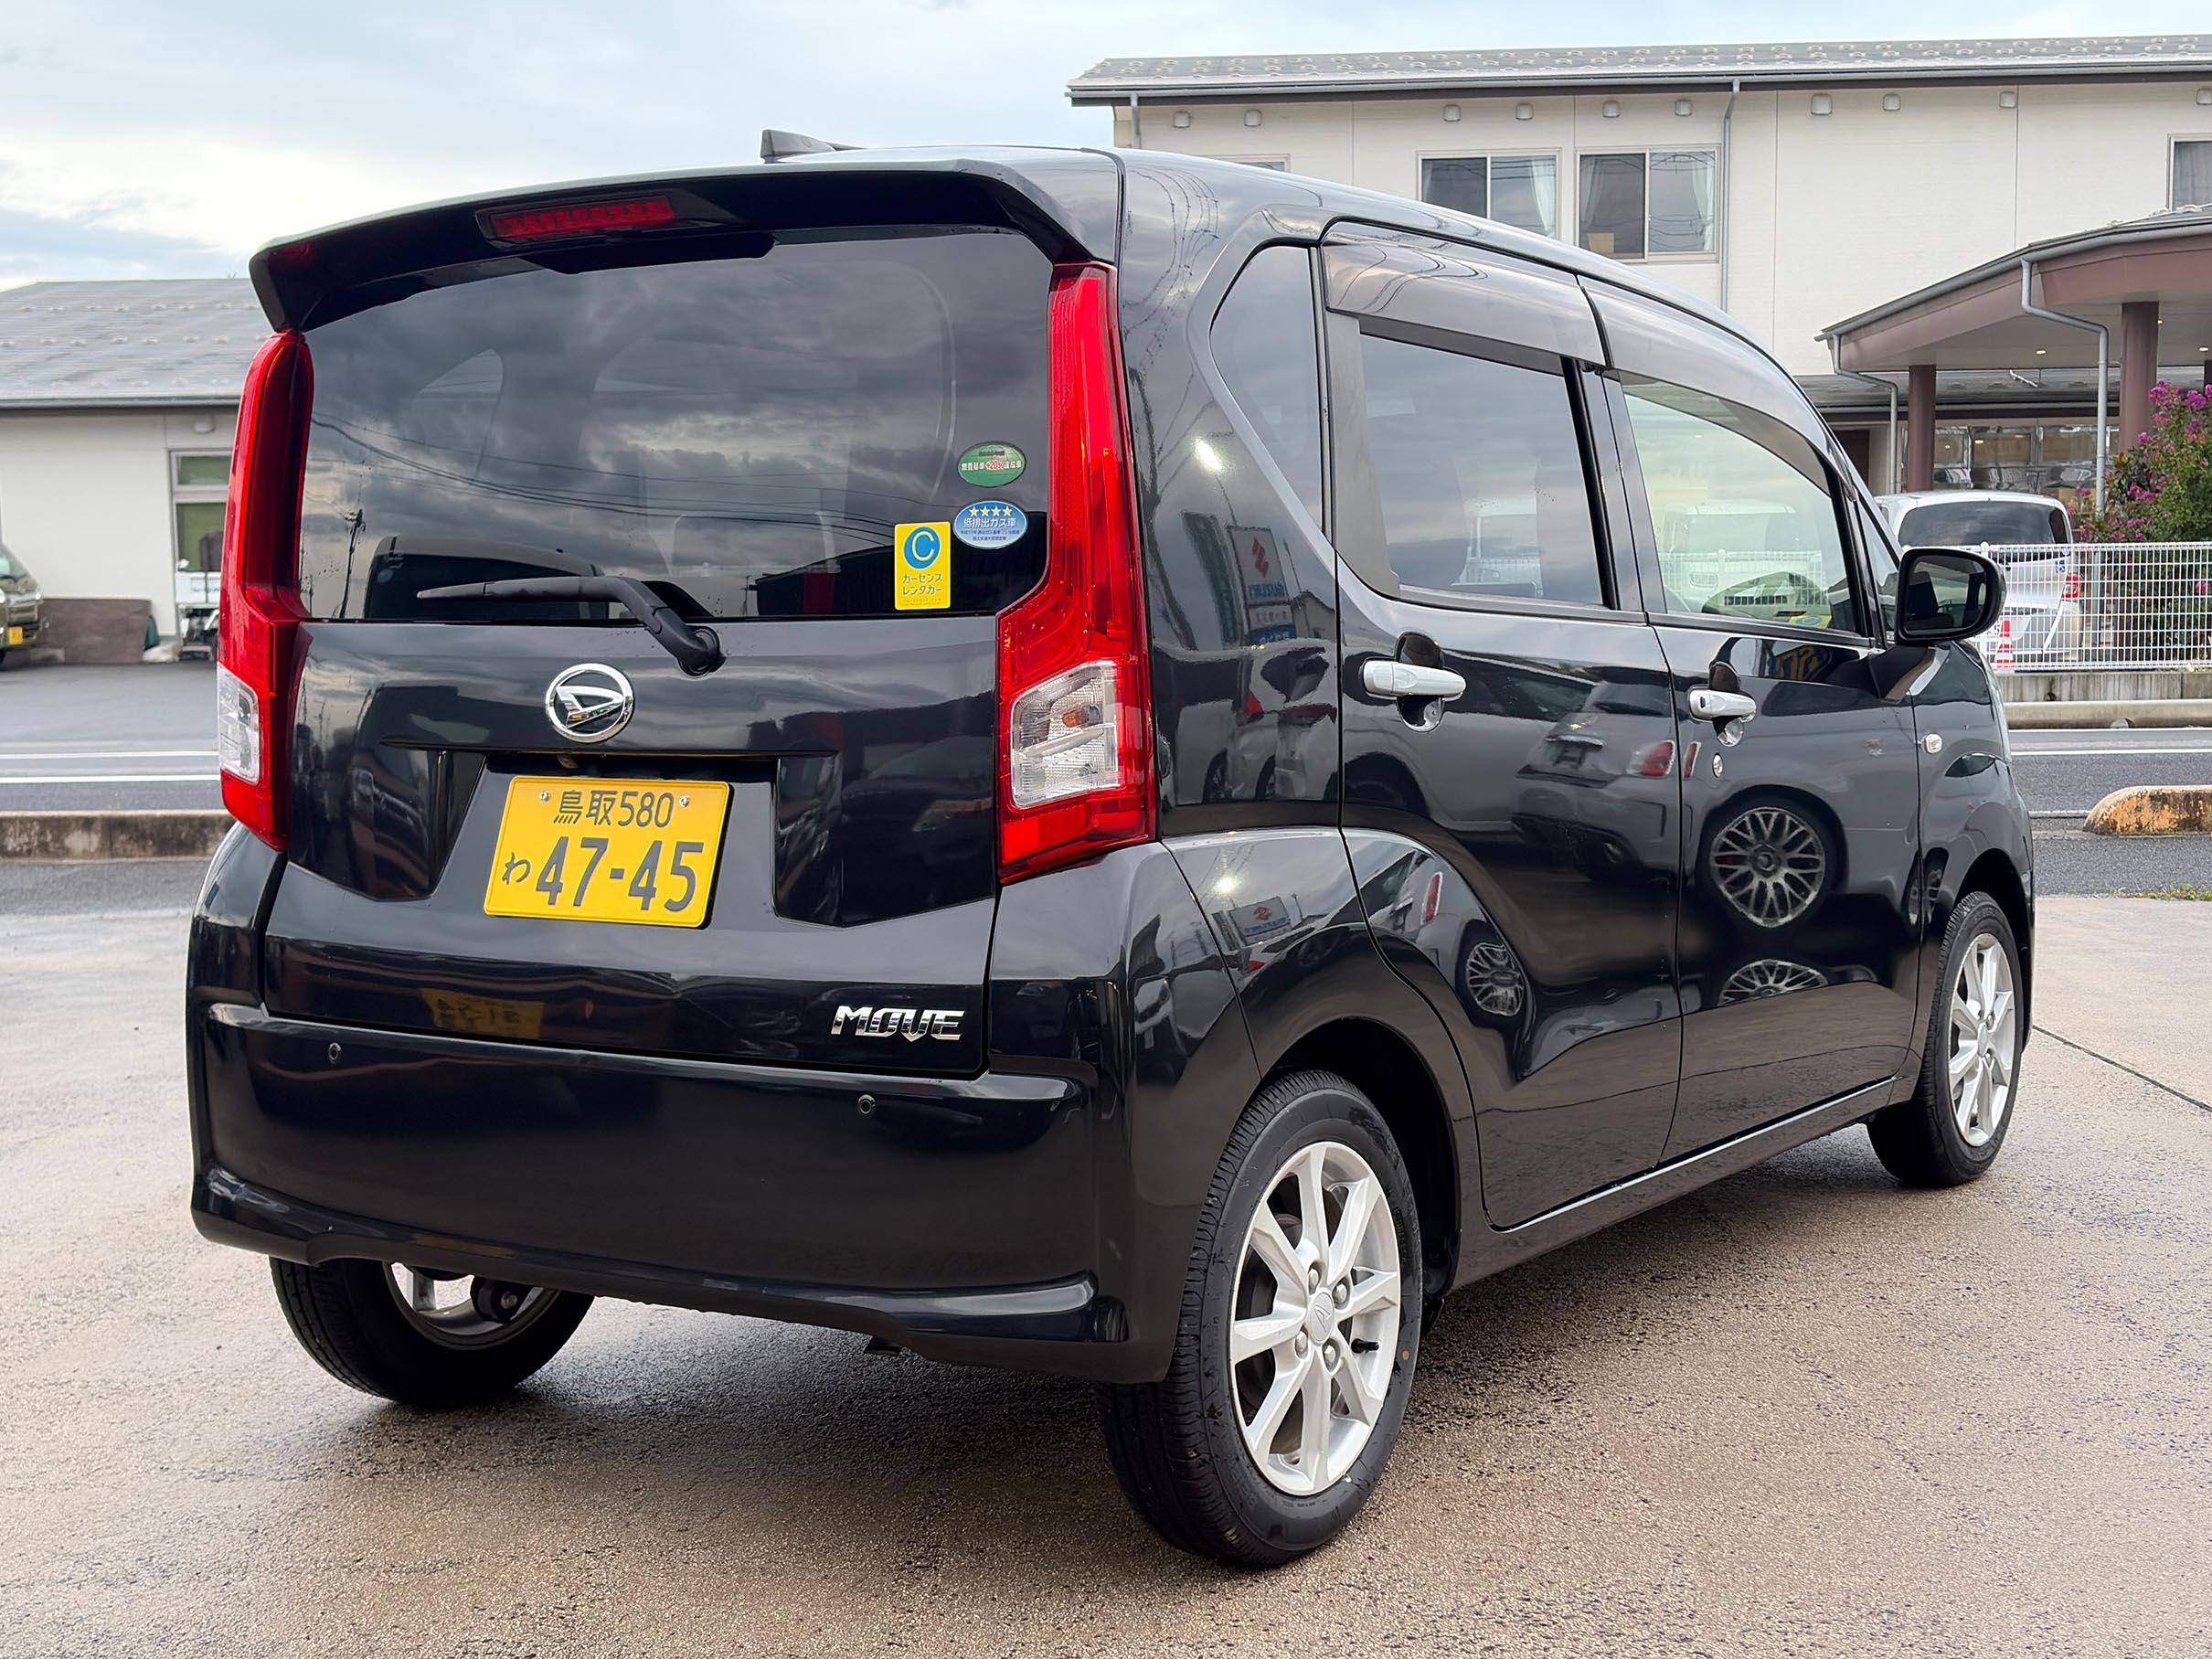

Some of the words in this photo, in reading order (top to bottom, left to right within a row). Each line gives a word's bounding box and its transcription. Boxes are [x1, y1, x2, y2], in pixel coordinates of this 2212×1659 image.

[963, 517, 1017, 528] 低排出ガス車
[902, 573, 942, 584] カーセンス
[902, 584, 942, 595] レンタカー
[502, 852, 531, 885] わ
[536, 835, 704, 912] 47-45
[831, 1005, 965, 1043] MOVE
